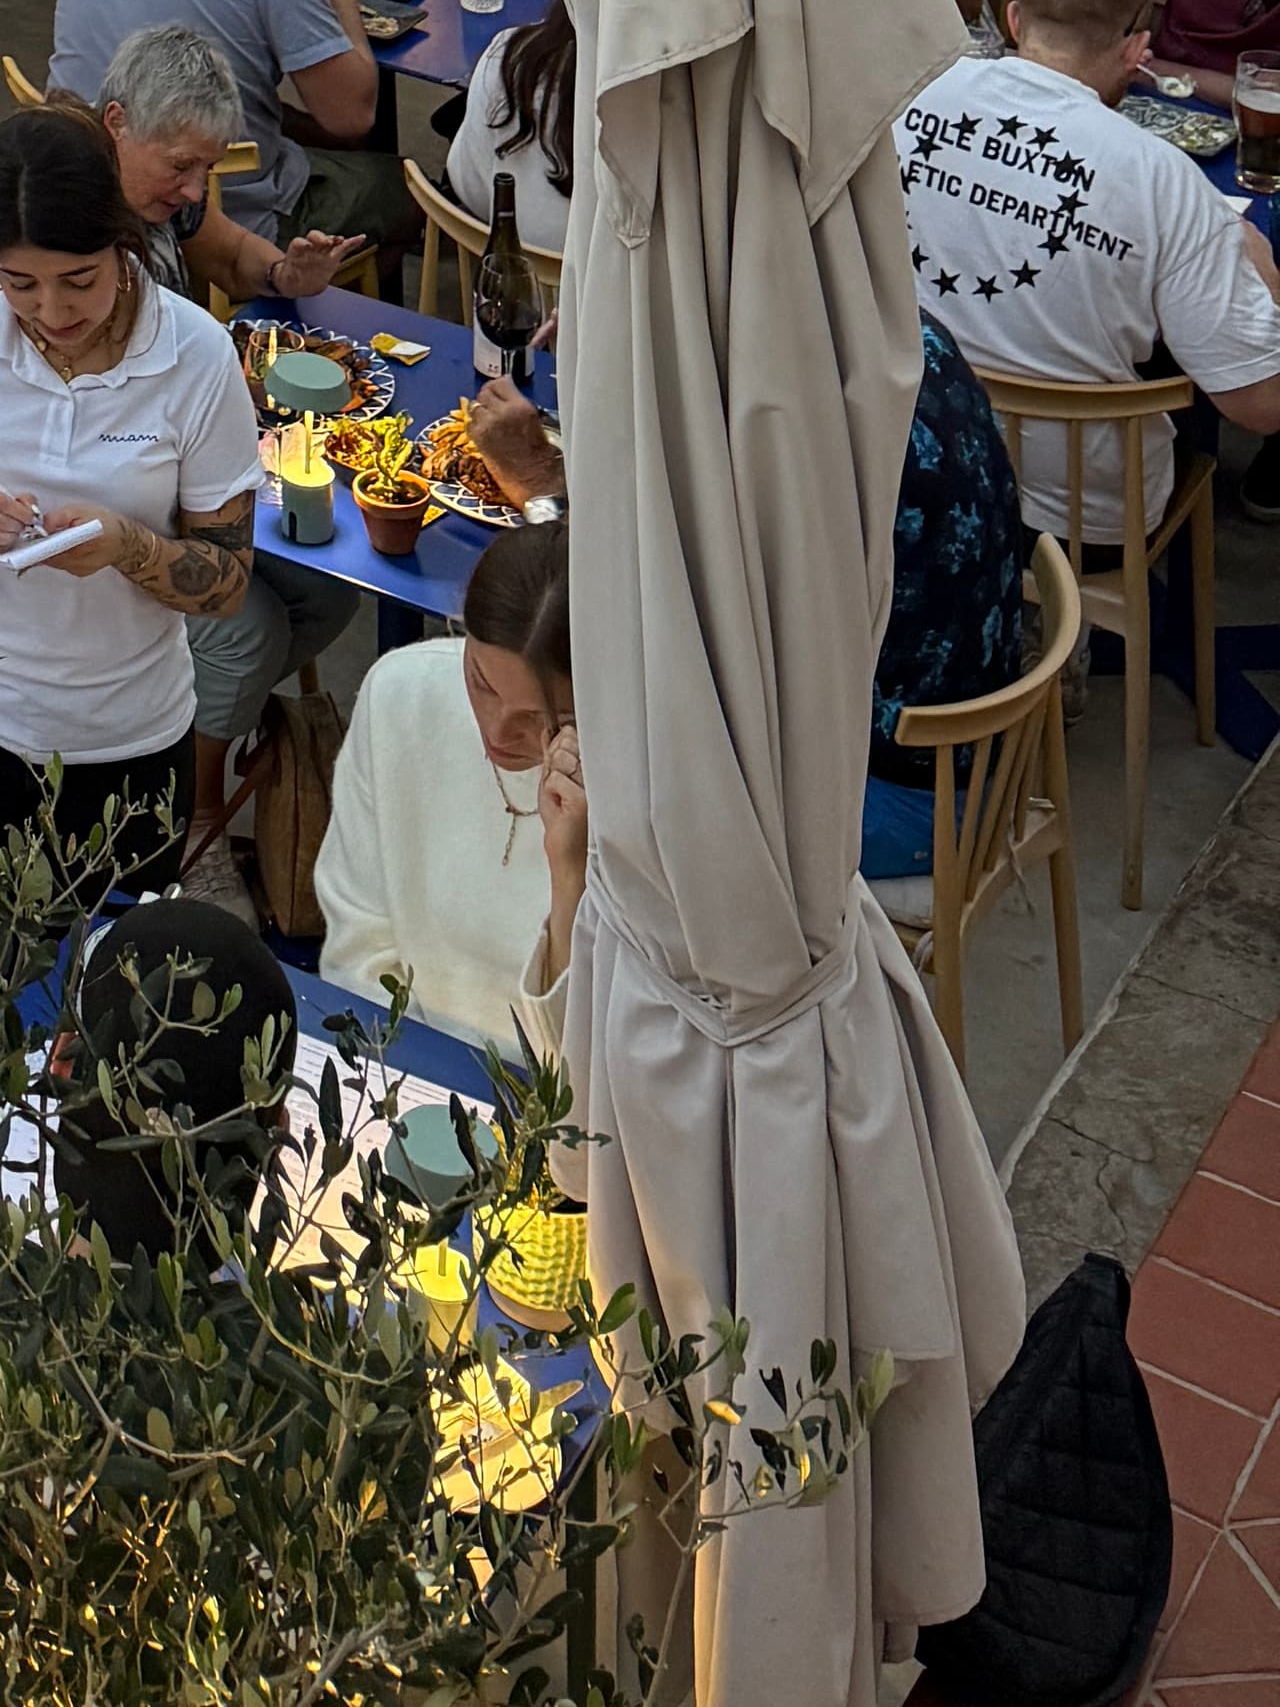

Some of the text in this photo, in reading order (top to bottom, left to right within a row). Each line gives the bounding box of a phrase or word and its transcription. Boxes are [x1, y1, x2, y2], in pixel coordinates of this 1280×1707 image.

[904, 107, 1095, 192] COLE BUXTON
[903, 159, 1134, 261] ETIC DEPARTMENT
